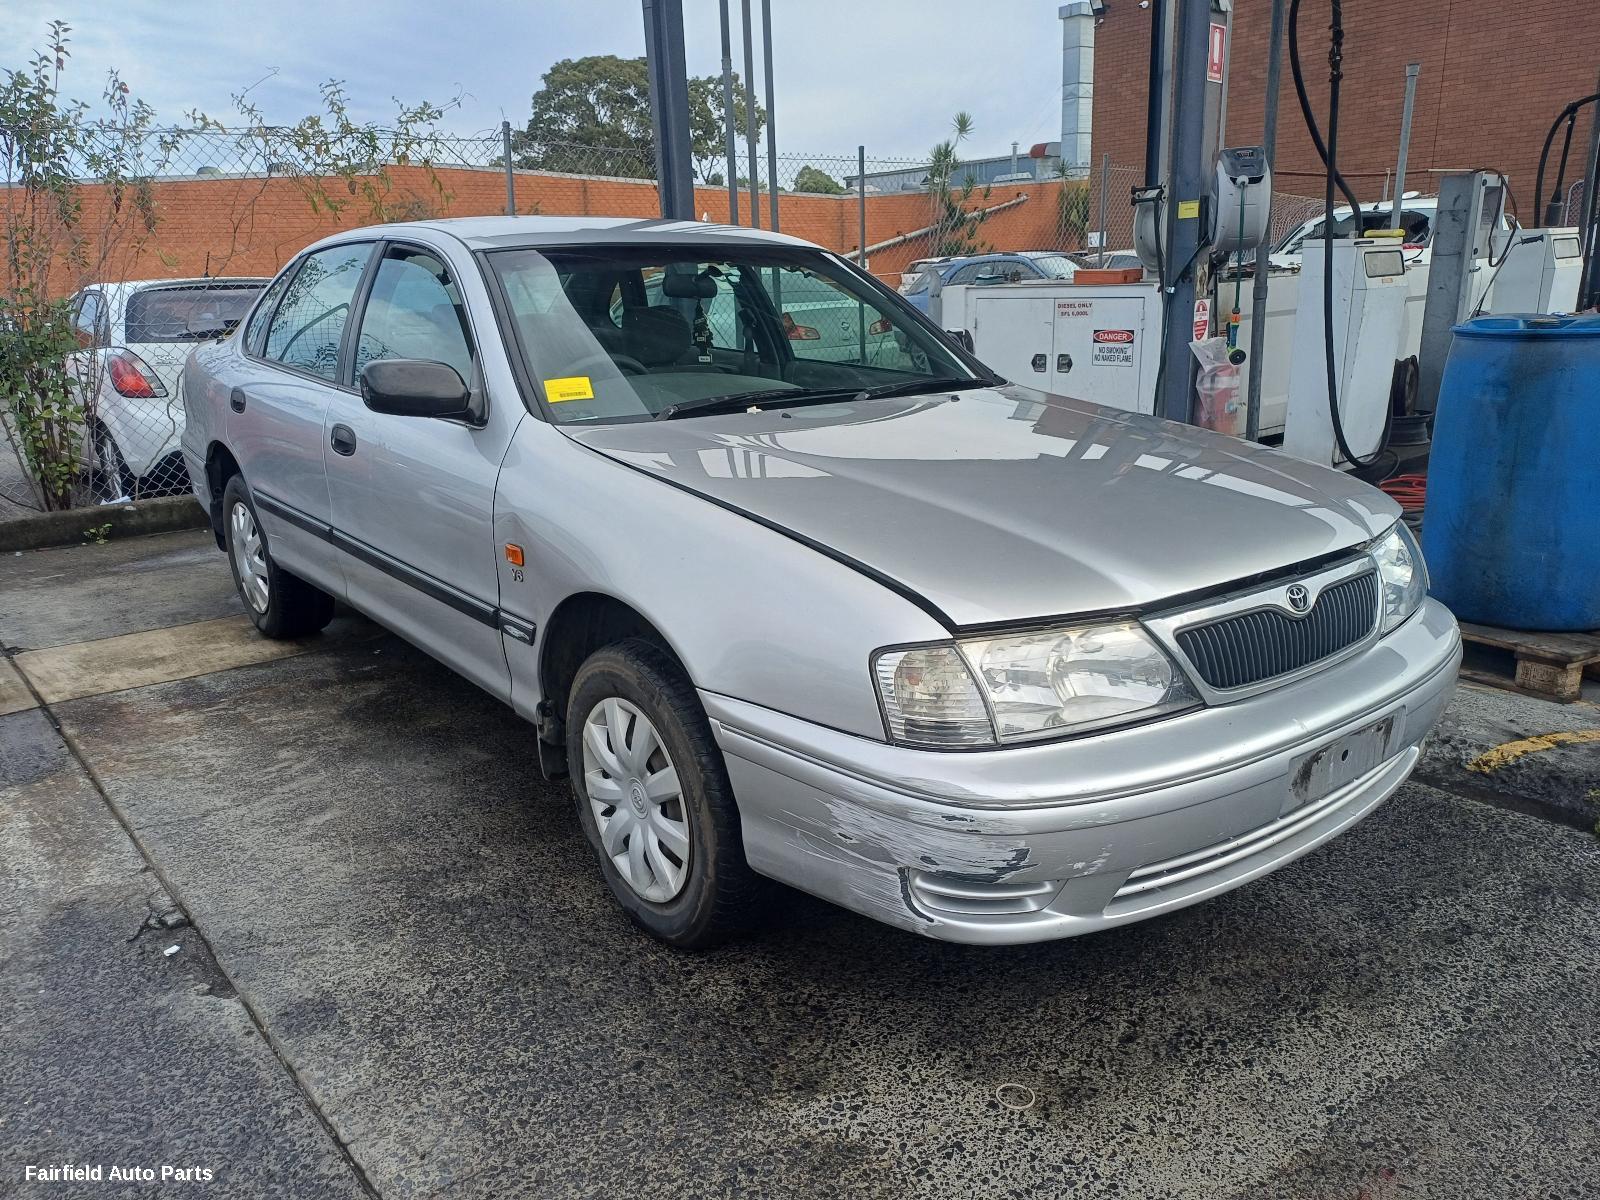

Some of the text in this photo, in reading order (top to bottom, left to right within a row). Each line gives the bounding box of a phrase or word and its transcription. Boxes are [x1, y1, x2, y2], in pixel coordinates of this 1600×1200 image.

[1099, 333, 1128, 341] DANGER
[1098, 346, 1128, 355] NO SMOKING
[1094, 354, 1132, 363] NO NAKED FLAME
